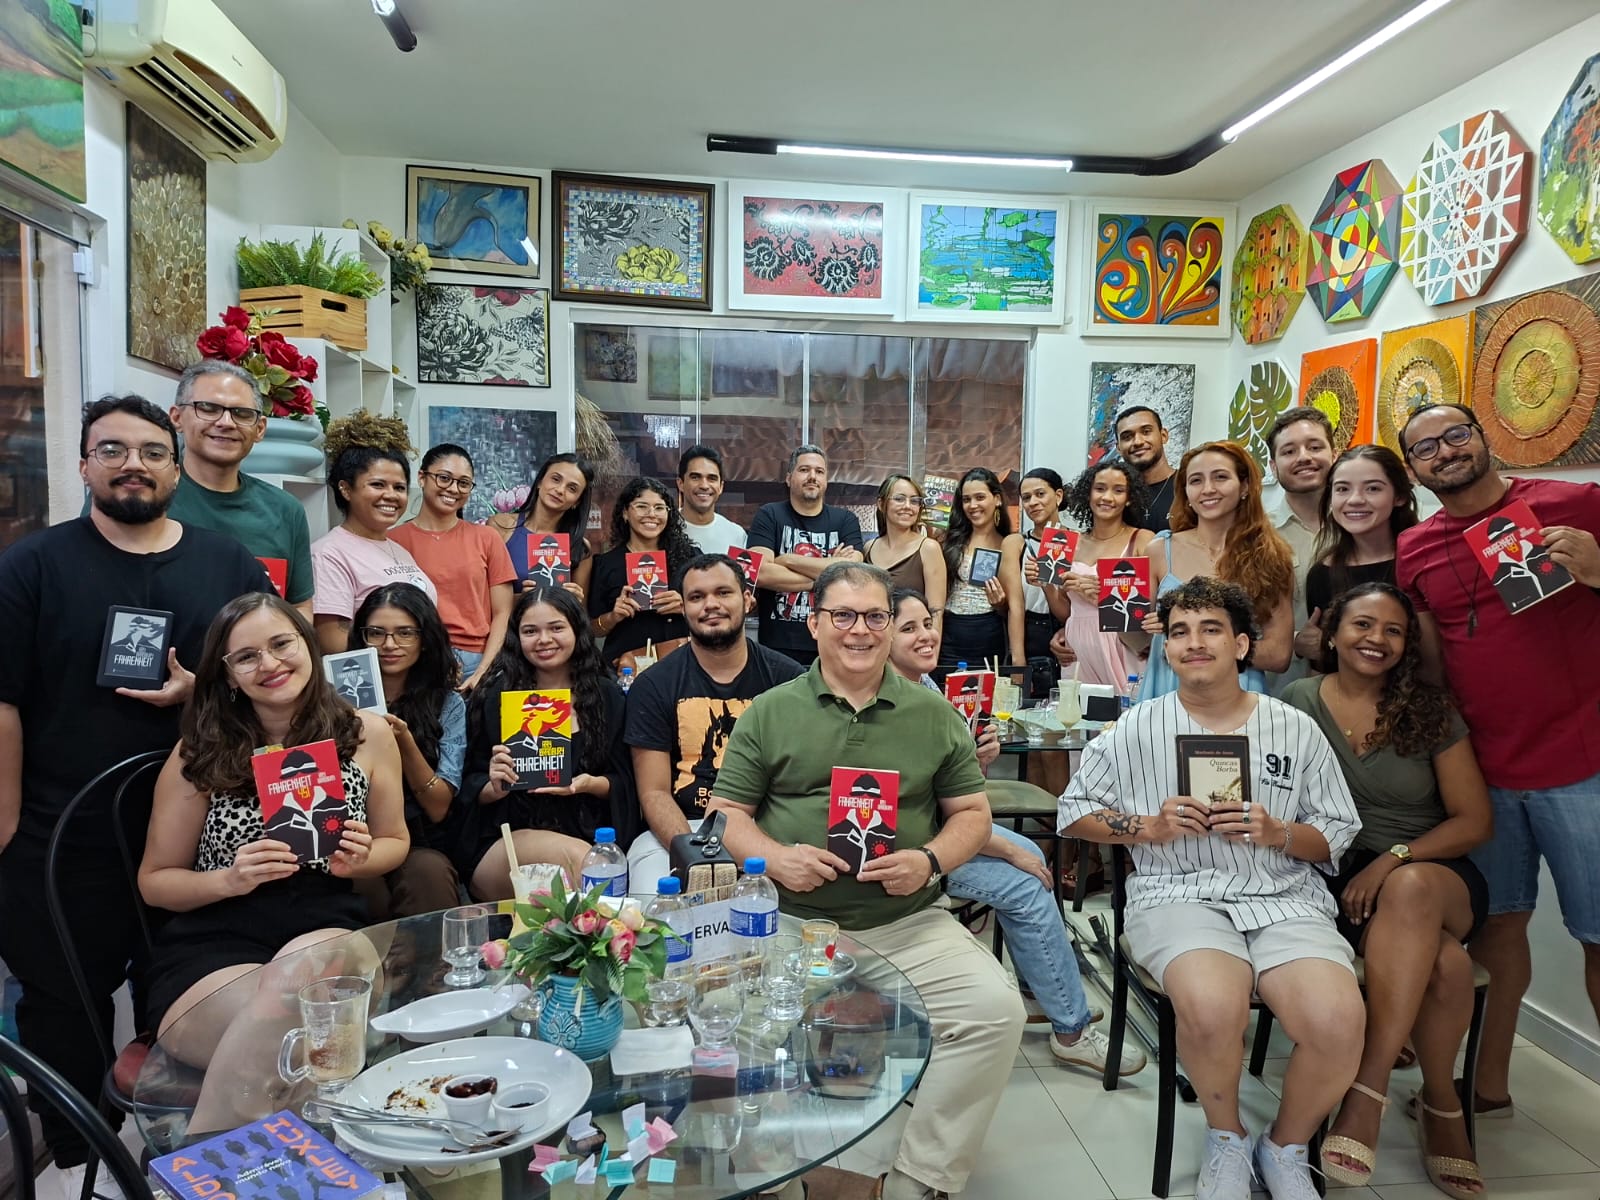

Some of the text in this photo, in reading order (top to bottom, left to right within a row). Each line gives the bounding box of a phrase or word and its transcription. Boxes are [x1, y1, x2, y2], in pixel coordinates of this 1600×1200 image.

[1482, 533, 1517, 558] FAHRENHEIT
[113, 654, 155, 668] FAHRENHEIT
[1209, 758, 1239, 767] Quincas
[267, 774, 313, 795] FAHRENHEIT
[838, 796, 875, 809] FAHRENHEIT
